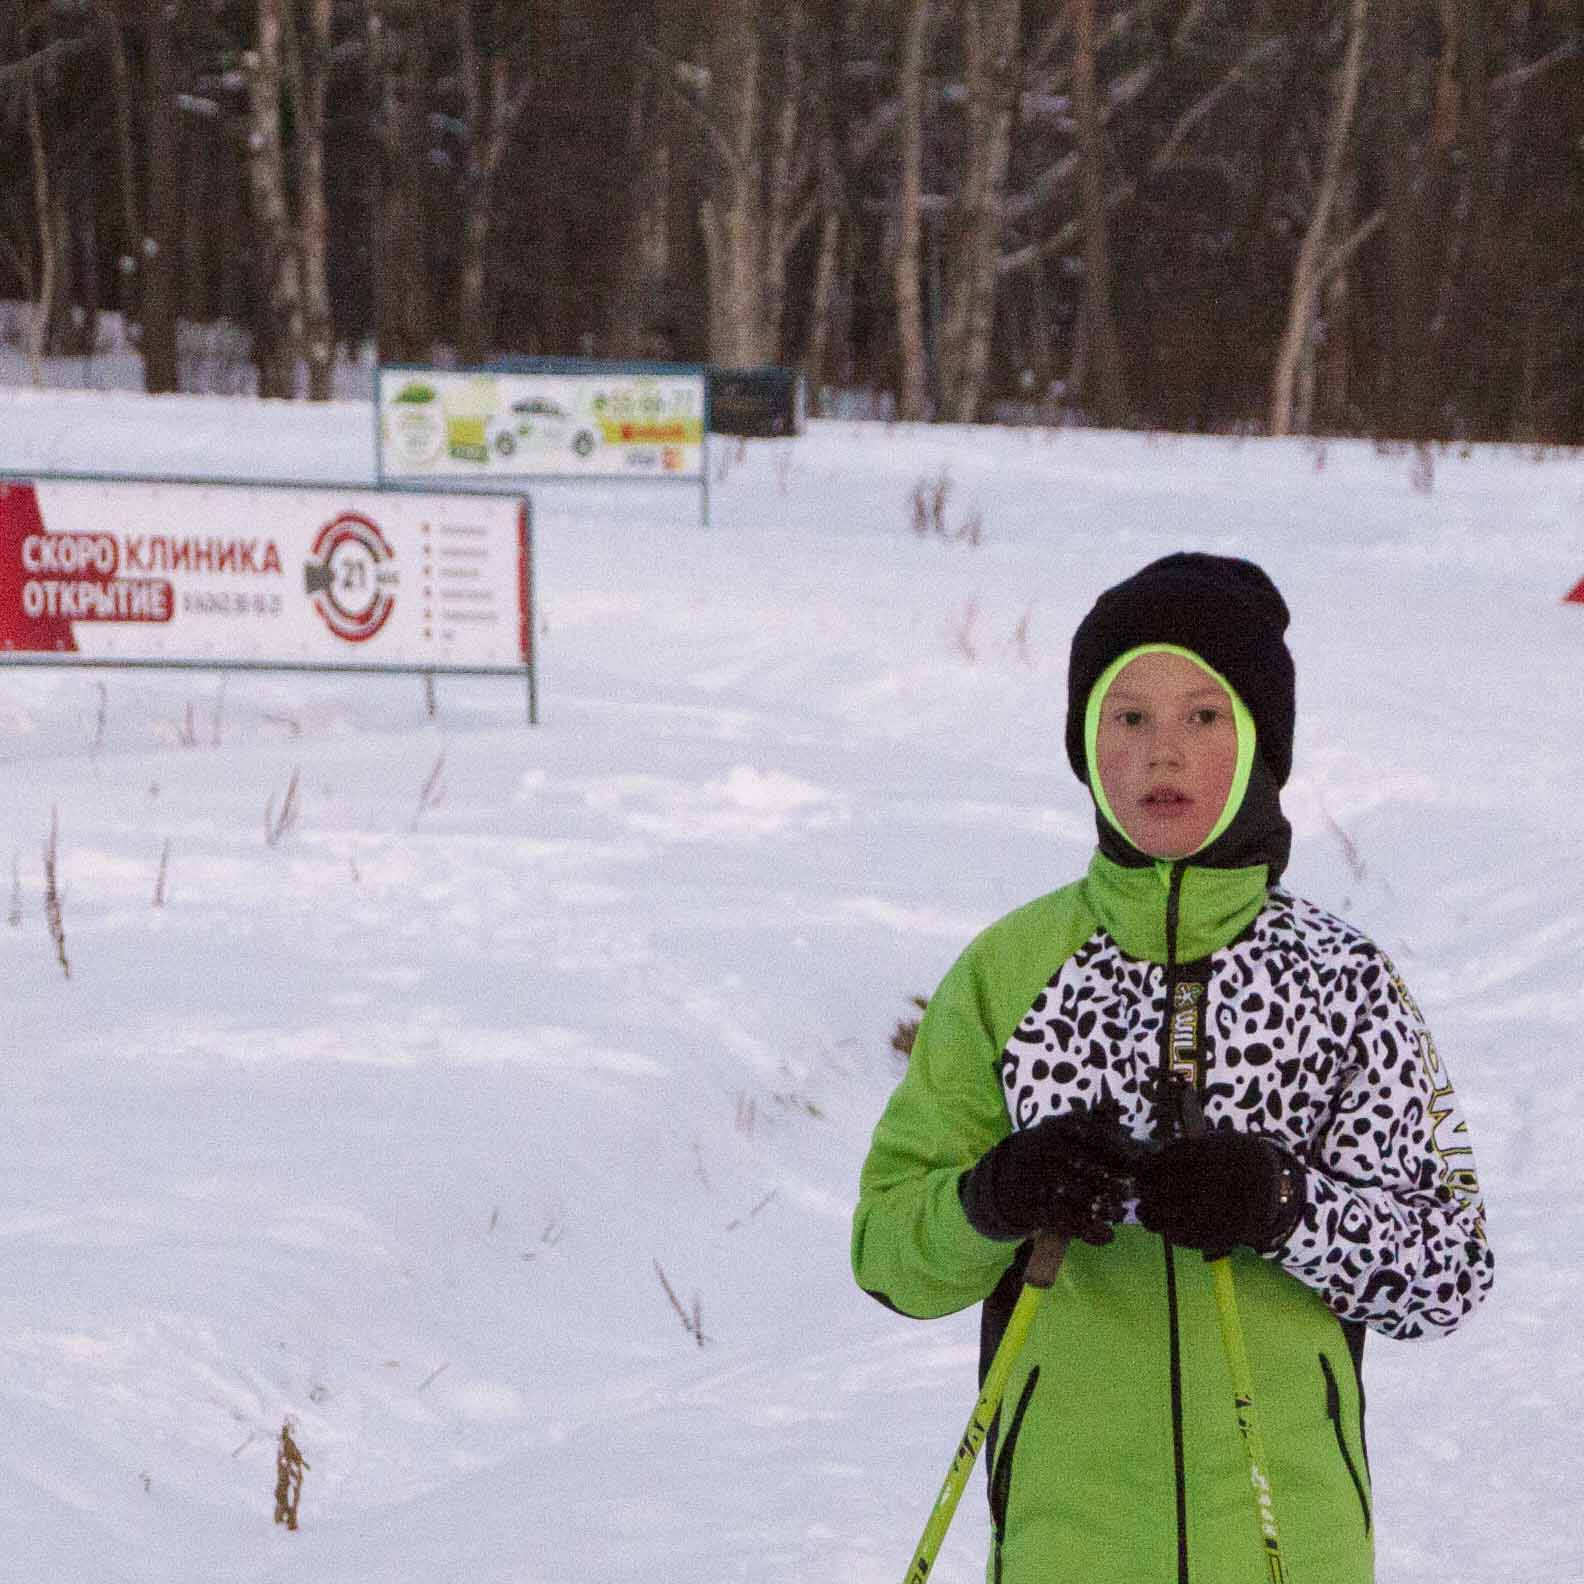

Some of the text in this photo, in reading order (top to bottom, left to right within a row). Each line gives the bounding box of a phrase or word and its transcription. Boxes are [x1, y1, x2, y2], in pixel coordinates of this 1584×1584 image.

[21, 535, 114, 573] СКОРО
[120, 536, 284, 577] КЛИНИКА
[22, 581, 167, 622] ОТКРЫТИЕ
